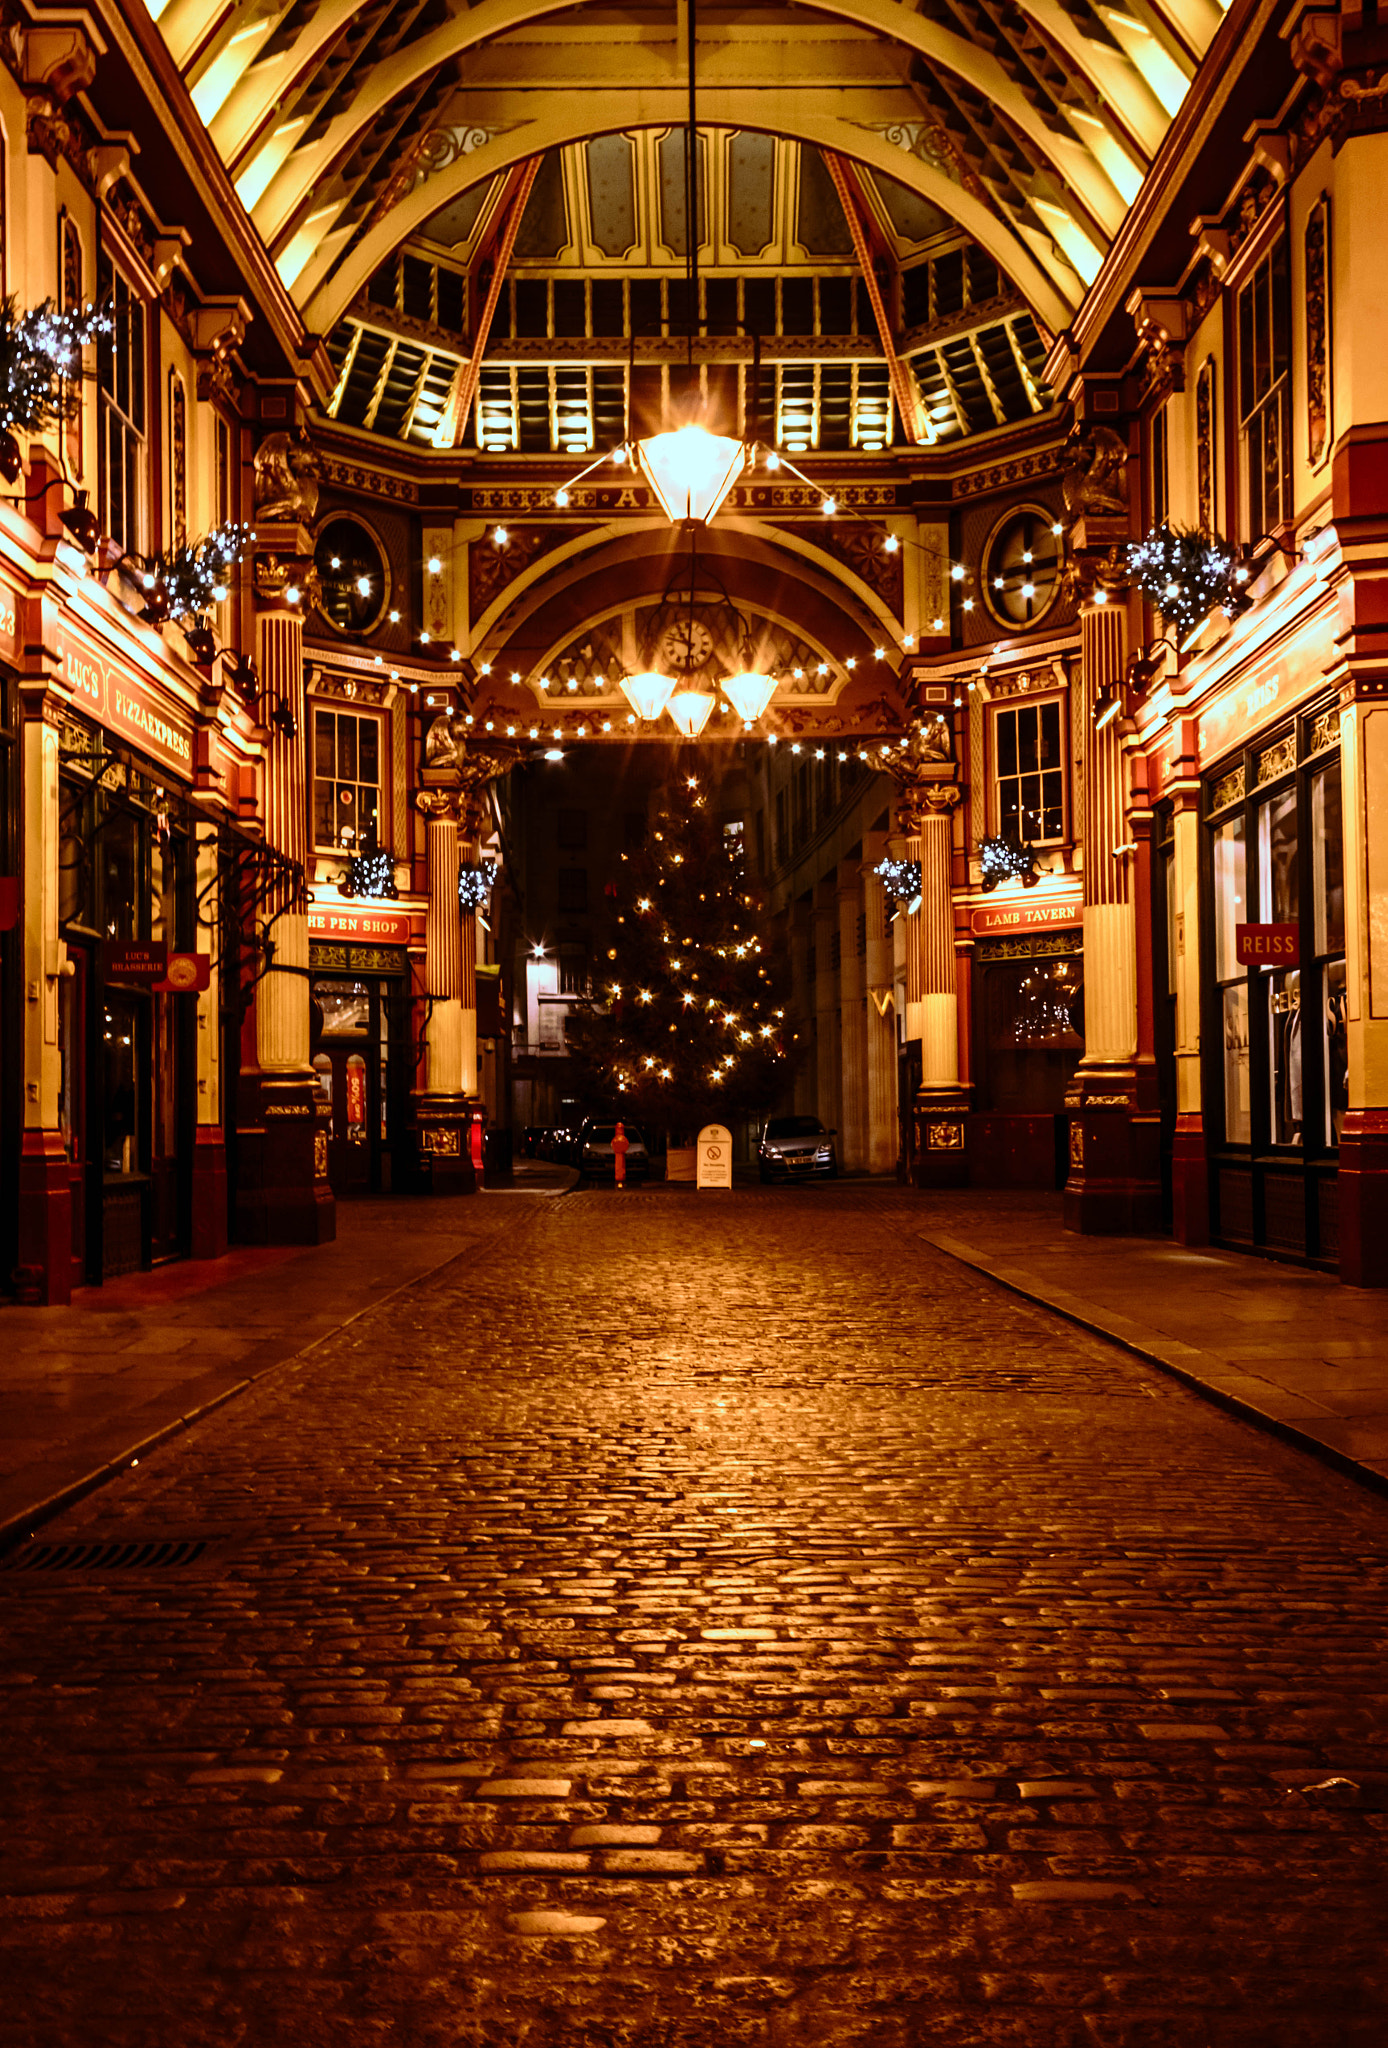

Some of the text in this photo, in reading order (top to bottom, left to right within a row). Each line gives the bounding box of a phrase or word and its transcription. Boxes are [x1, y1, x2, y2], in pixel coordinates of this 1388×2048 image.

[67, 652, 99, 699] LUC'S
[115, 688, 190, 760] PIZZAEXPRESS
[307, 915, 398, 934] HE PEN SHOP
[985, 906, 1076, 927] LAMB TAVERN
[1242, 936, 1295, 954] REISS
[125, 951, 150, 961] LUC'S
[111, 962, 163, 972] BRASSERIE
